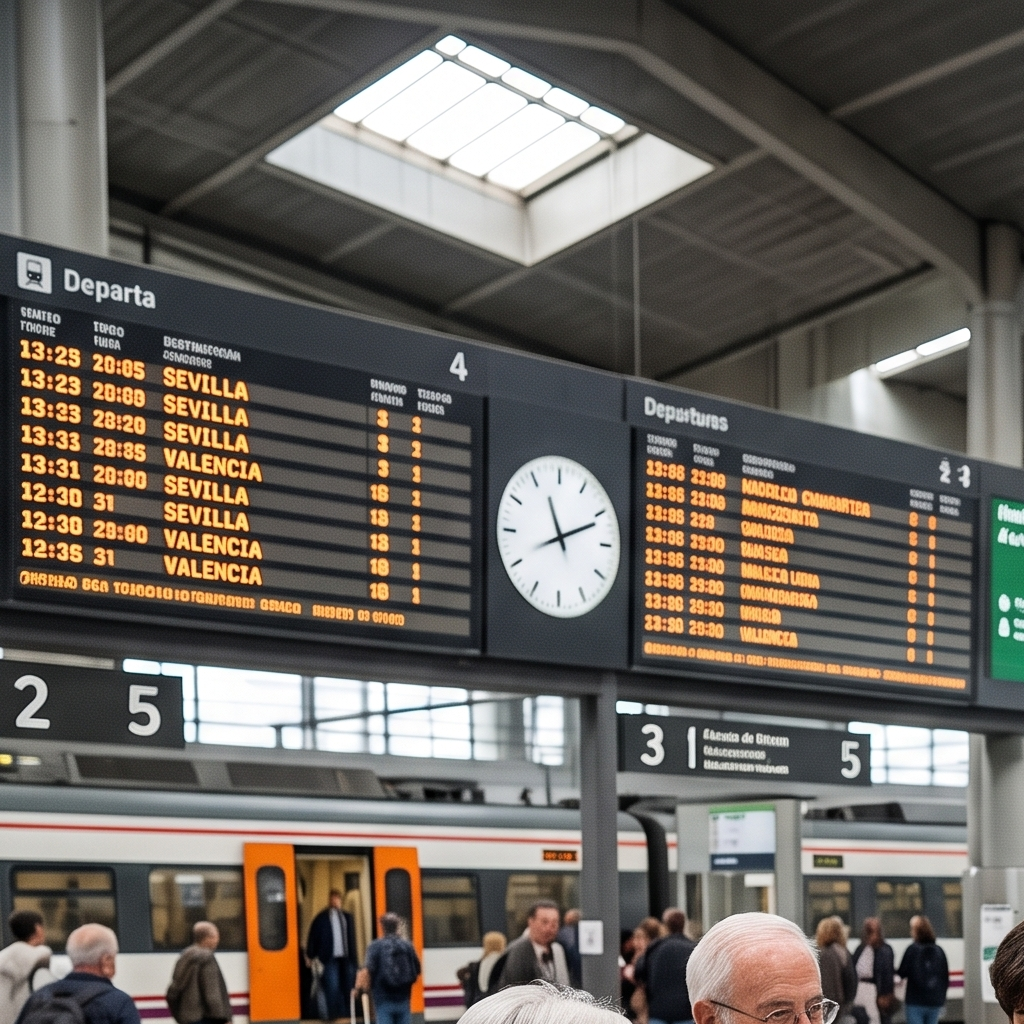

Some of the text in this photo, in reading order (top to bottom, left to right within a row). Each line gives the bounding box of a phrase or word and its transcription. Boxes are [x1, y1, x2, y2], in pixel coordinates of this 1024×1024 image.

[64, 268, 156, 309] Departa
[20, 339, 81, 368] 13:25
[163, 366, 249, 402] SEVILLA
[449, 351, 468, 382] 4
[20, 368, 81, 396] 13:23
[163, 393, 249, 428] SEVILLA
[163, 420, 250, 454] SEVILLA
[21, 453, 82, 480] 13:31
[163, 474, 250, 506] SEVILLA
[163, 447, 263, 483] VALENCIA
[21, 481, 83, 508] 12:30
[163, 501, 250, 532] SEVILLA
[21, 537, 84, 563] 12:35
[163, 555, 263, 587] VALENCIA
[163, 528, 263, 562] VALENCIA
[13, 674, 162, 737] 2 5
[640, 723, 666, 767] 3
[840, 740, 862, 779] 5
